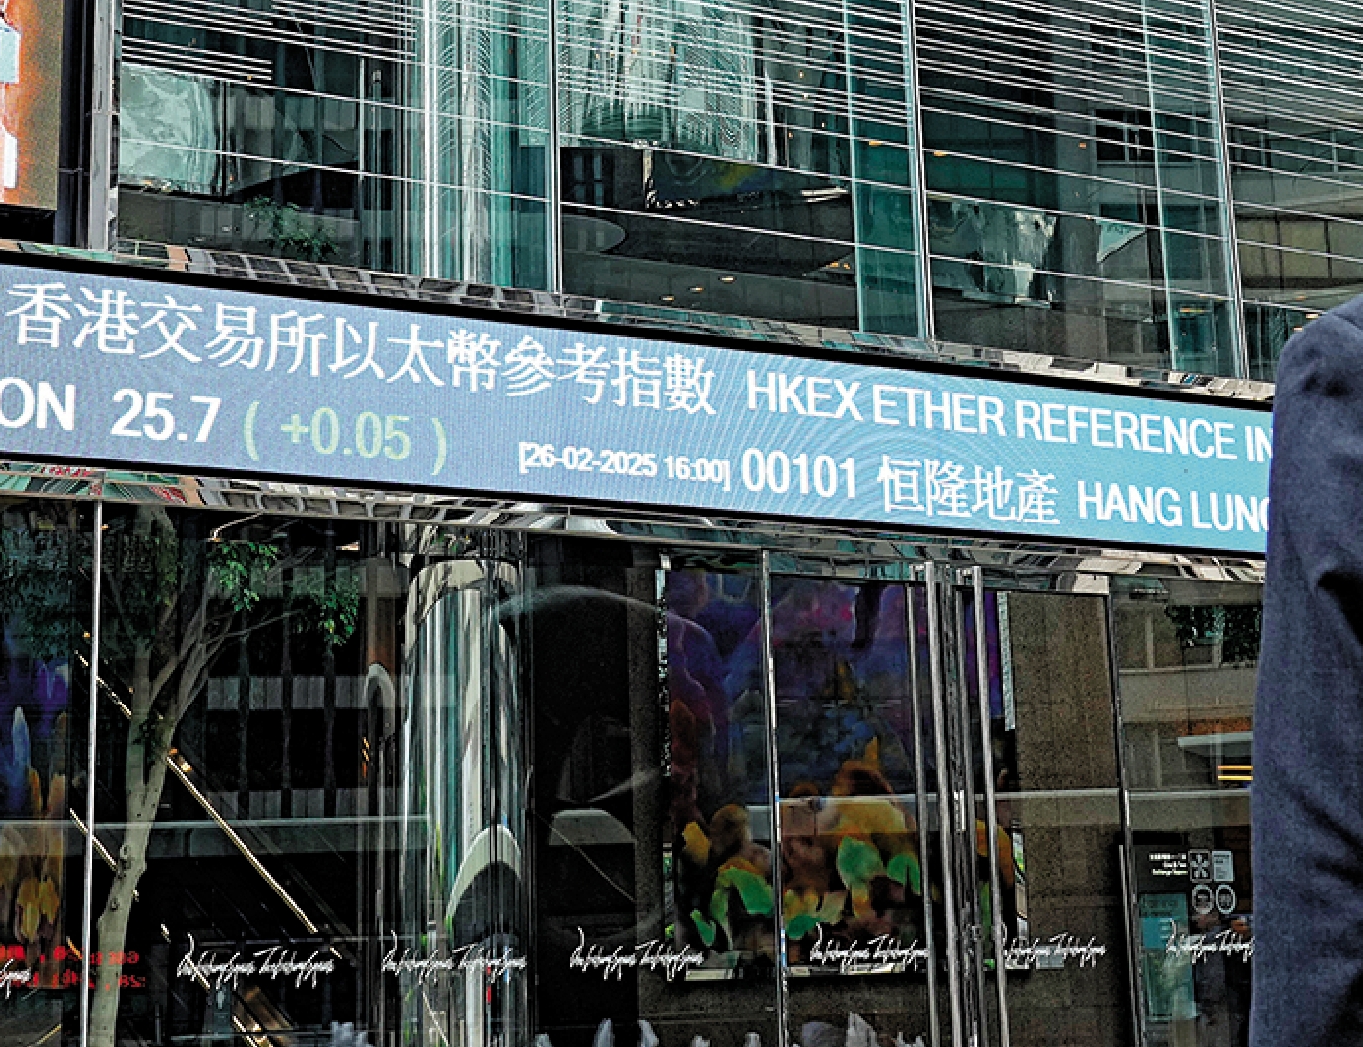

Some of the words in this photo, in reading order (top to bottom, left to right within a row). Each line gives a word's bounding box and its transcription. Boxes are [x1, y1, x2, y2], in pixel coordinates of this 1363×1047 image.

[4, 281, 717, 415] 香港交易所以太幣參考指數
[746, 369, 864, 421] HKEX
[872, 384, 1006, 437] ETHER
[1015, 400, 1238, 460] REFERENCE
[111, 388, 221, 443] 25.7
[518, 441, 658, 478] [26-02-2025
[665, 455, 731, 492] 16:00]
[741, 447, 856, 499] 00101
[877, 455, 1061, 525] 恒隆地產
[1077, 480, 1181, 527] HANG
